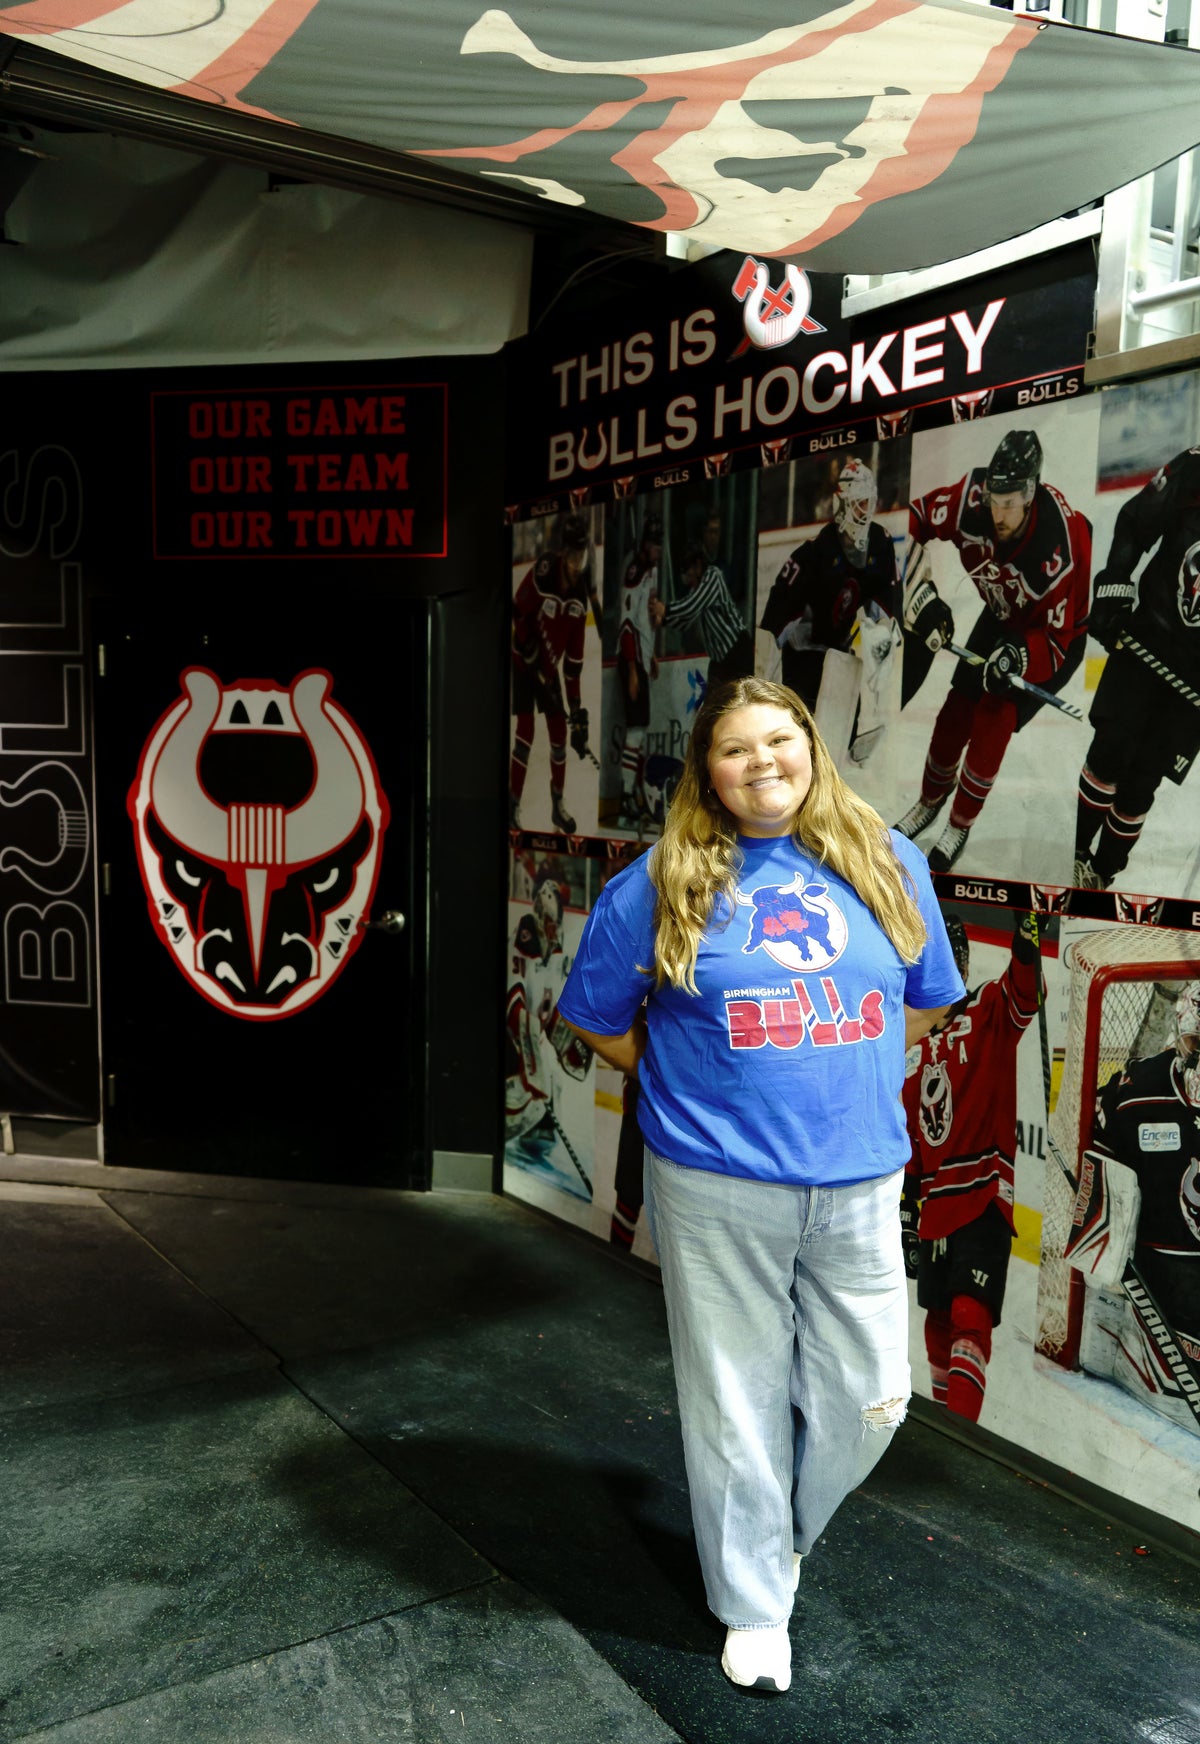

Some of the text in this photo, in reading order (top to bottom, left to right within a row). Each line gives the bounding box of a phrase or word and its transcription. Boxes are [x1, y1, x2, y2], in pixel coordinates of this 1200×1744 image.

[552, 309, 717, 407] THIS IS
[548, 297, 1007, 481] BULLS HOCKEY
[1017, 377, 1079, 406] BULLS
[189, 396, 406, 439] OUR GAME
[809, 429, 857, 453] BULLS
[190, 453, 409, 493] OUR TEAM
[191, 508, 414, 548] OUR TOWN
[955, 883, 1008, 903] BULLS
[724, 986, 791, 999] BIRMINGHAM
[725, 976, 885, 1050] BULLS
[1123, 1278, 1200, 1414] WARRIOR
